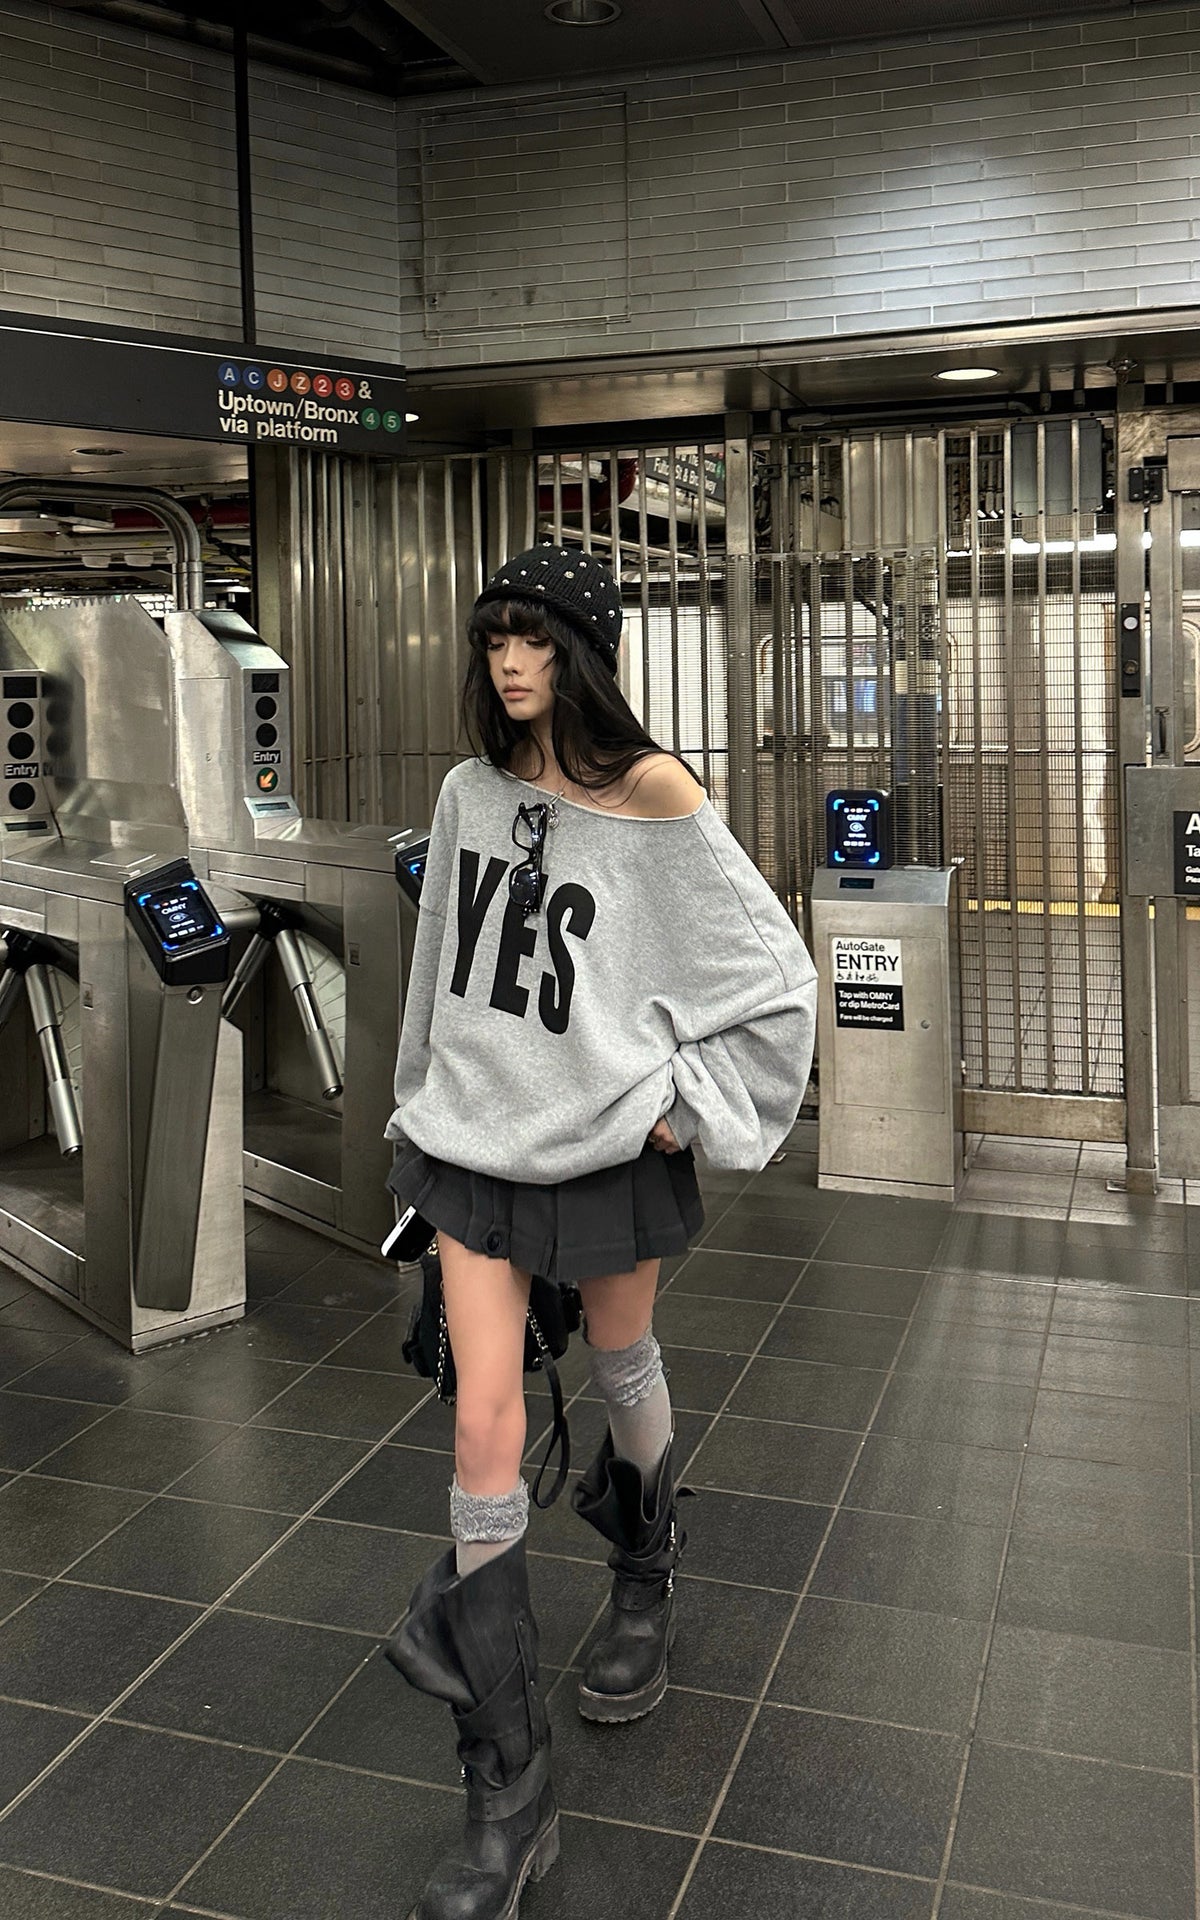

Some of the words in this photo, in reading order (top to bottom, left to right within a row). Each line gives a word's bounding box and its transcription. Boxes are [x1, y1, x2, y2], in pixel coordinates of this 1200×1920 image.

[357, 380, 372, 399] &
[218, 389, 359, 425] Uptown/Bronx
[219, 414, 249, 434] via
[256, 417, 338, 443] platform
[252, 751, 280, 763] Entry
[4, 764, 38, 778] Entry
[450, 848, 596, 1034] YES
[836, 940, 885, 952] AutoGate
[836, 953, 899, 971] ENTRY
[838, 990, 853, 1000] Tap
[853, 991, 868, 999] with
[869, 991, 894, 1000] OMNY
[848, 1000, 860, 1009] dip
[860, 1001, 900, 1011] MetroCard
